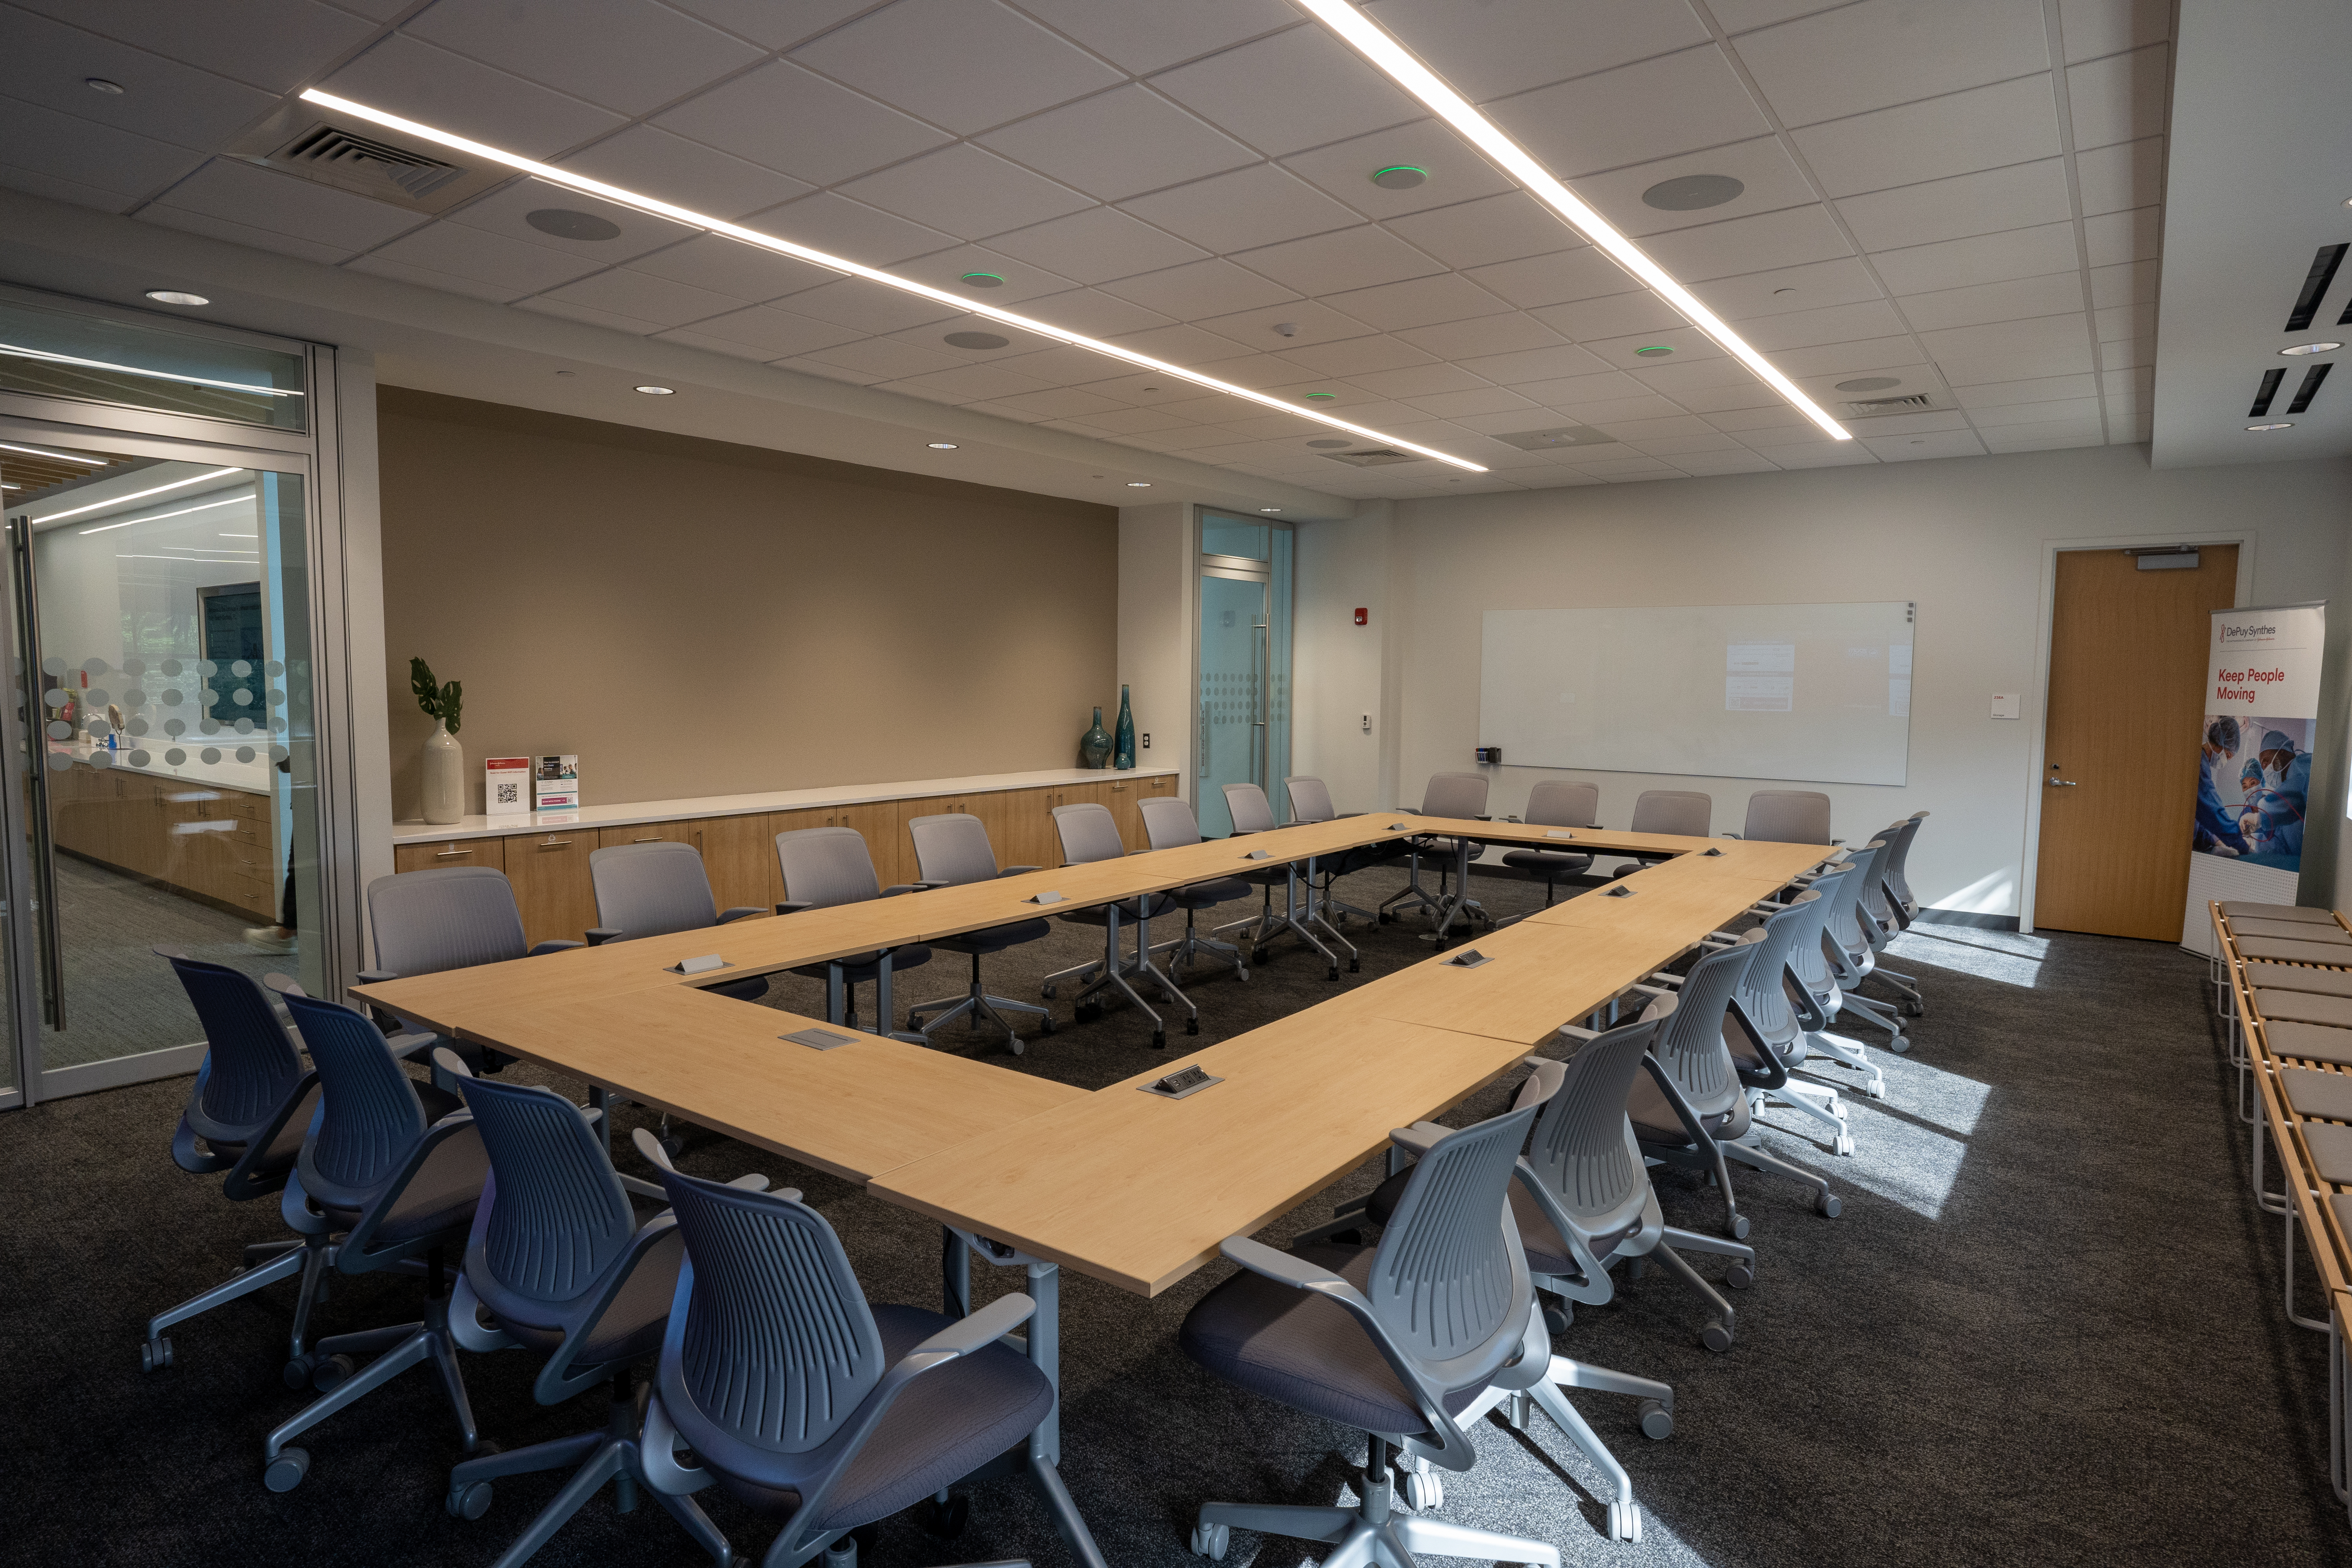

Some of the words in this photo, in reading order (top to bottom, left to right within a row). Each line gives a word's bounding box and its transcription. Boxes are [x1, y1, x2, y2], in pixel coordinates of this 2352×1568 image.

[2227, 627, 2249, 638] DePuy
[2249, 625, 2276, 637] Synthes
[2218, 668, 2245, 685] Keep
[2247, 668, 2285, 685] People
[2217, 686, 2255, 704] Moving
